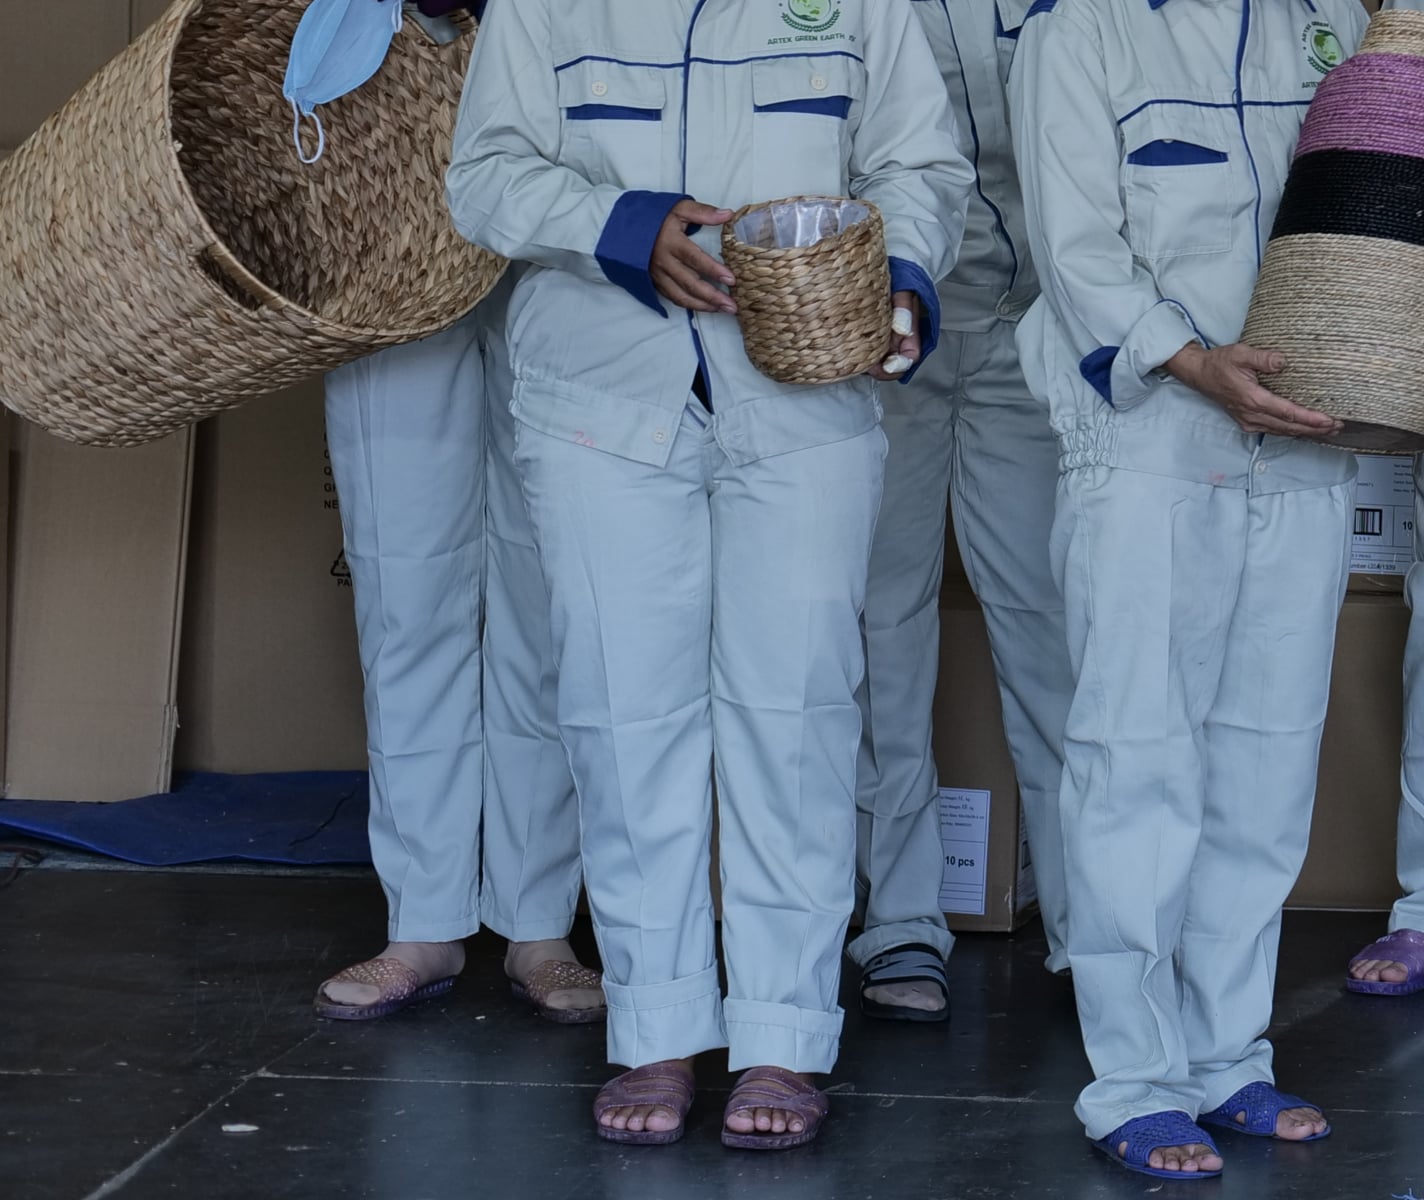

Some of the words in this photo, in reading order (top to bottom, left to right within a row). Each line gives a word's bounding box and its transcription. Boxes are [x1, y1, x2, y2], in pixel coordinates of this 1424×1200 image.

[767, 37, 792, 45] ARTEX
[795, 34, 818, 42] GREEN
[1403, 521, 1413, 531] 10
[946, 856, 955, 865] 10
[958, 859, 975, 867] pcs
